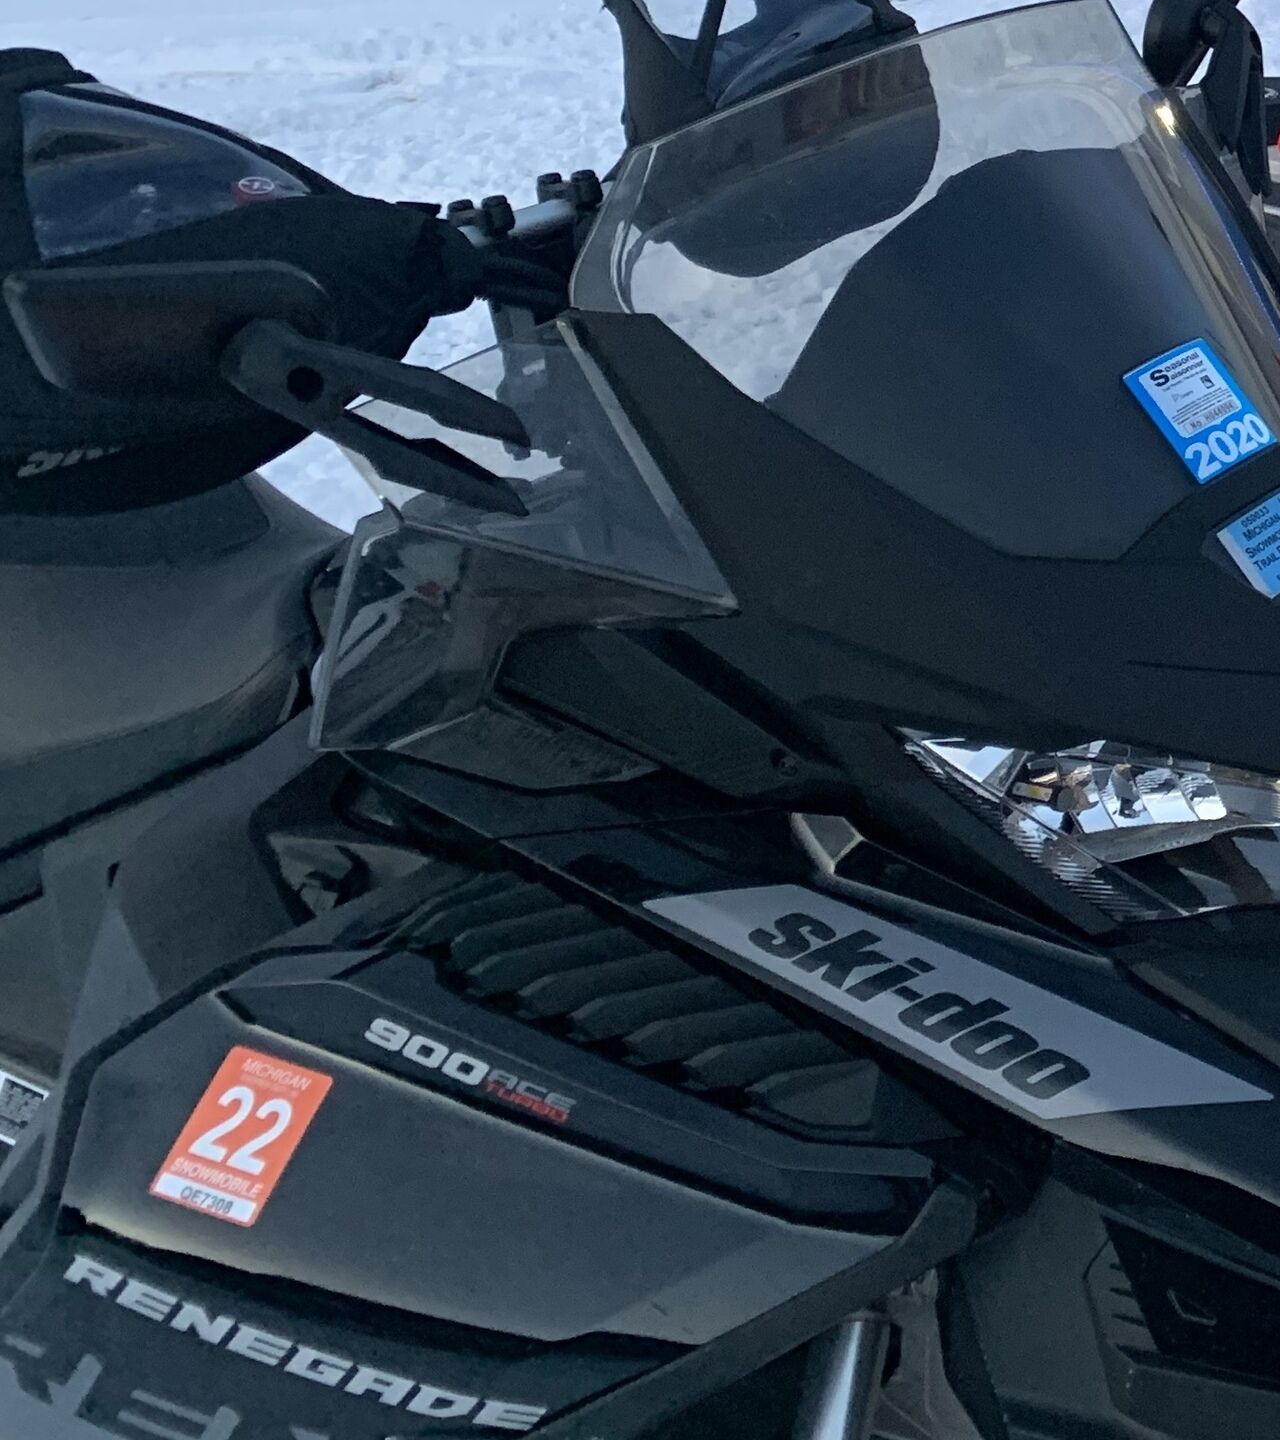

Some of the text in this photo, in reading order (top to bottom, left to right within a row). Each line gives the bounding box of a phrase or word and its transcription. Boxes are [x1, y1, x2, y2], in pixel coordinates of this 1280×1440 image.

[1184, 412, 1271, 479] 2020
[1241, 512, 1280, 543] MICHIGAN
[1252, 551, 1280, 572] TRAIL
[747, 911, 1092, 1101] ski-doo
[240, 1057, 313, 1091] MICHIGAN
[363, 1017, 491, 1087] 900
[485, 1069, 578, 1114] ACE
[187, 1085, 293, 1177] 22
[170, 1157, 265, 1200] SNOWMOBILE
[62, 1254, 548, 1432] RENEGADE
